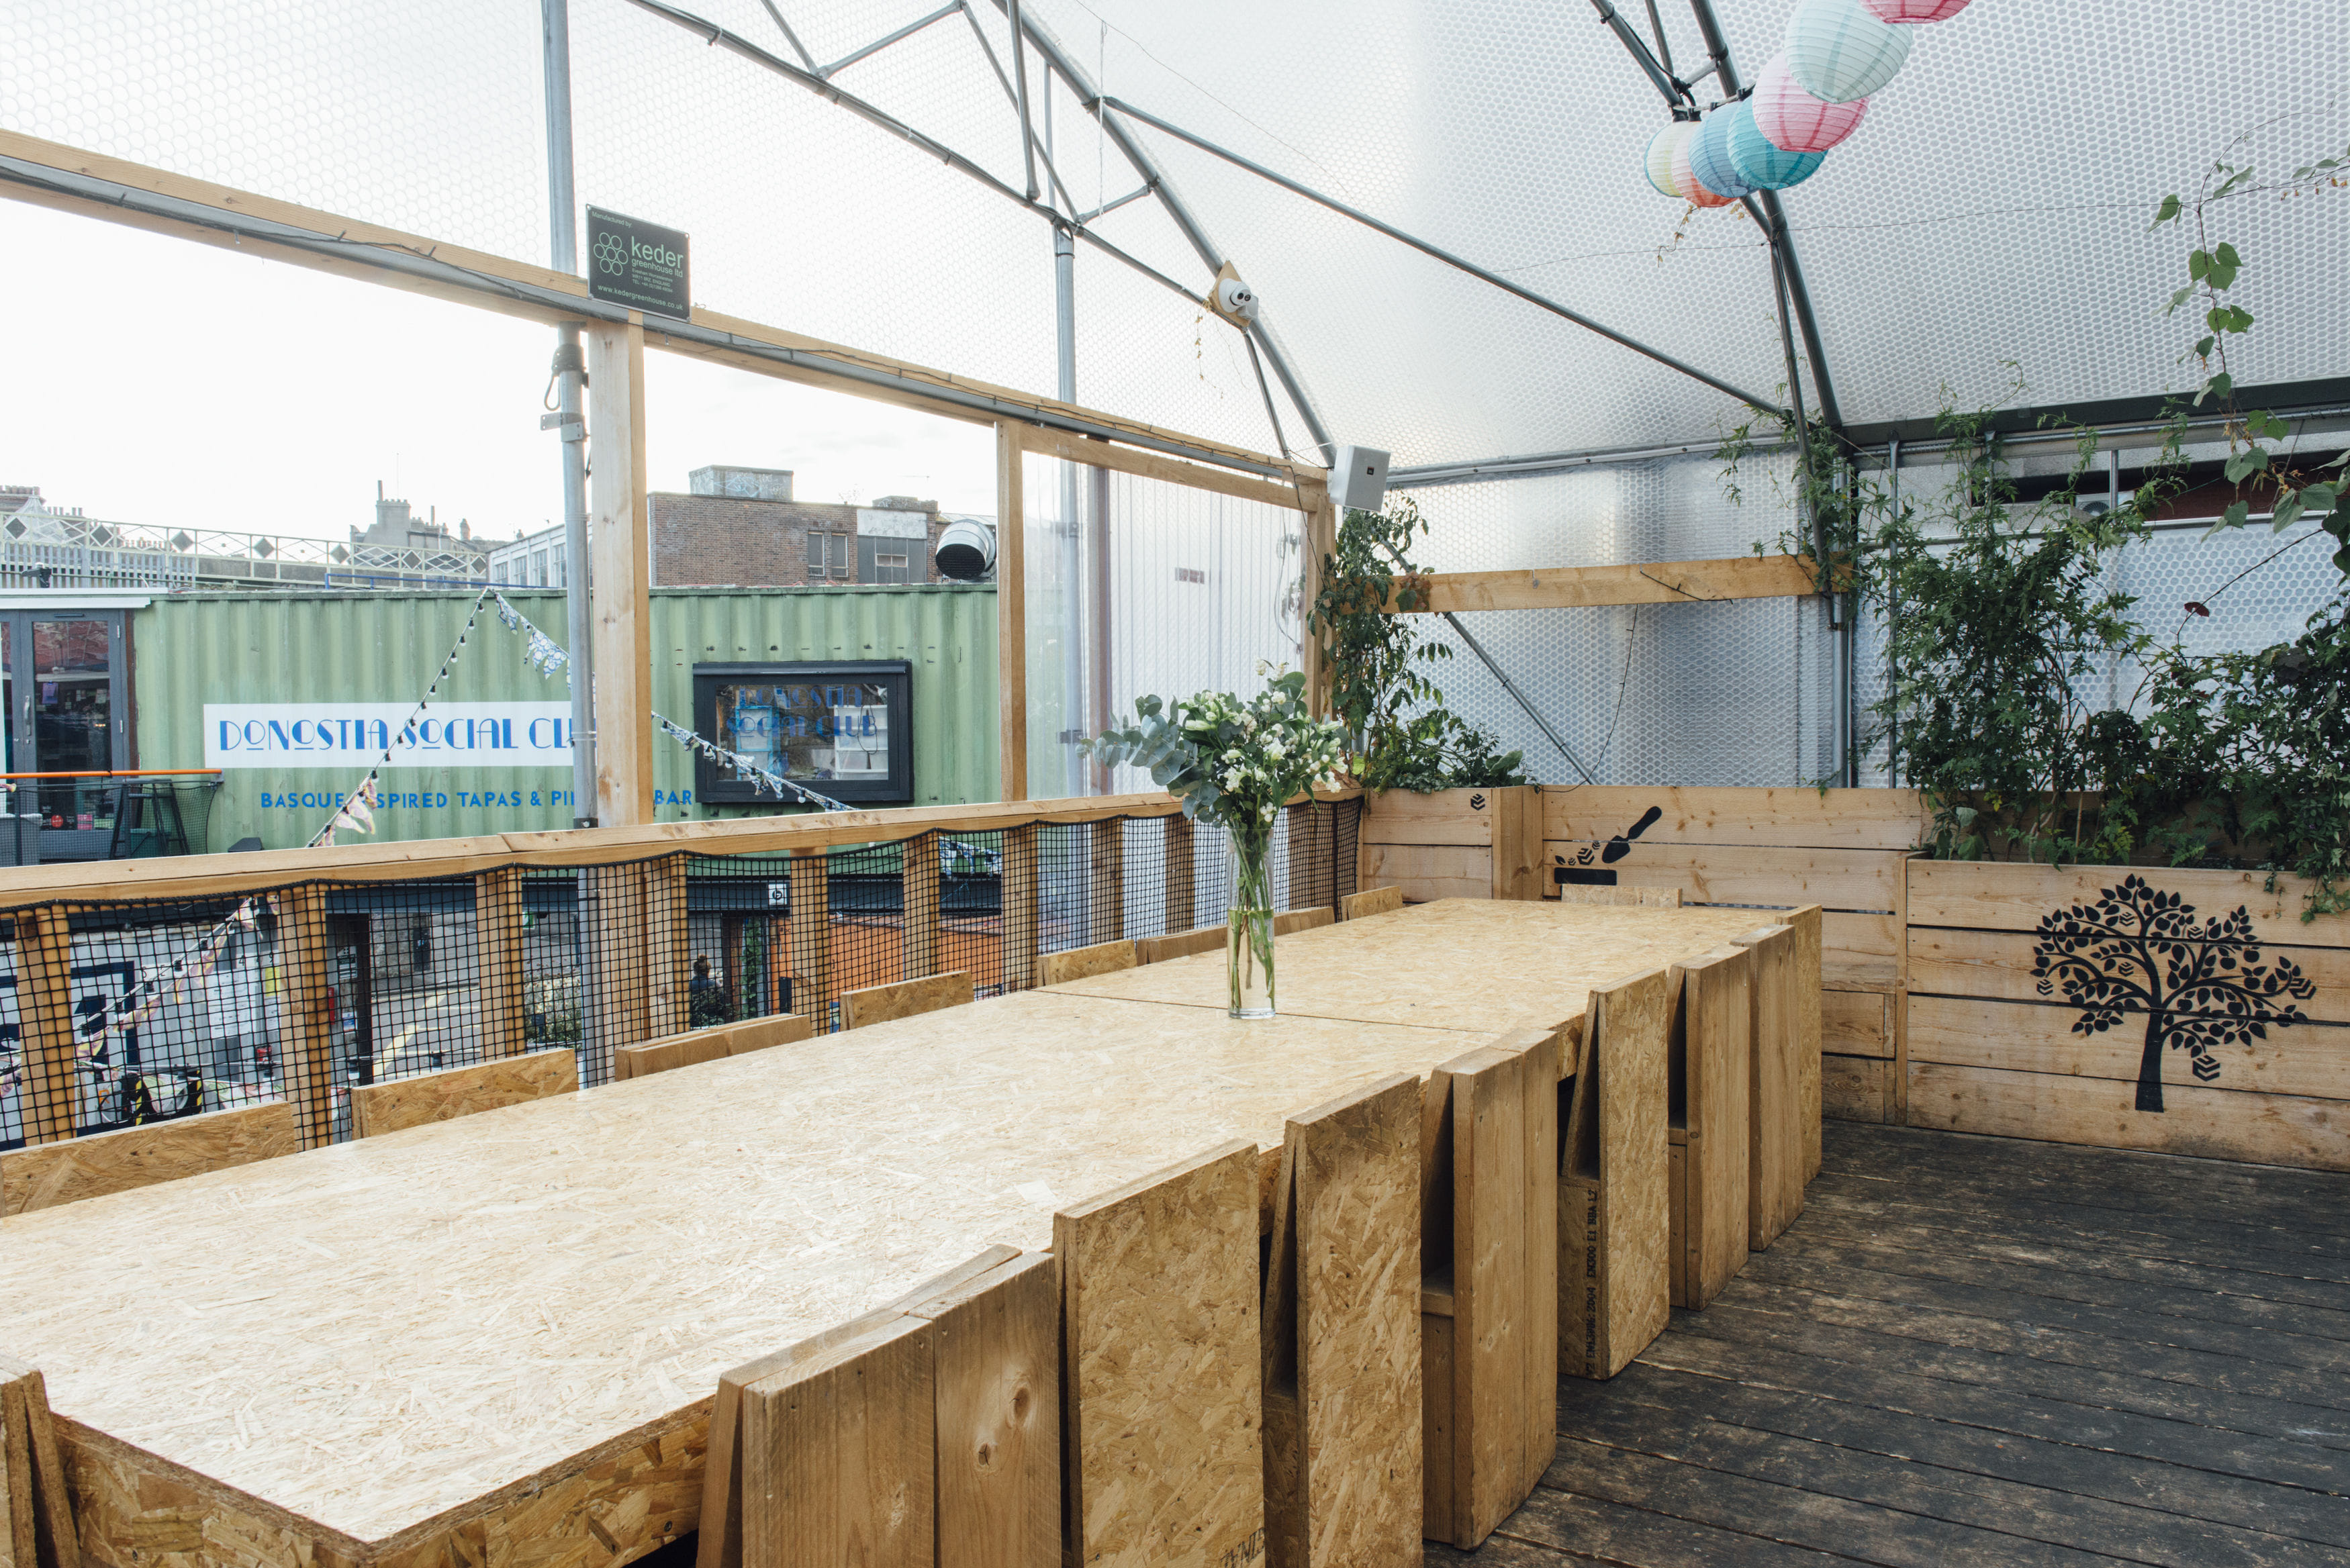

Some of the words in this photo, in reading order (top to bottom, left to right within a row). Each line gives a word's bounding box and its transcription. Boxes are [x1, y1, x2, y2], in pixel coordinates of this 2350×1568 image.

[592, 211, 624, 225] Manufactured
[631, 236, 684, 269] keder
[632, 258, 673, 275] greenhouse
[674, 268, 684, 278] ltd
[597, 284, 684, 311] www.kedergreenhouse.co.uk
[739, 687, 863, 709] DONOSTIA
[220, 719, 388, 750] DONOSTIA
[403, 718, 519, 750] SOCIAL
[726, 716, 810, 737] SOCIAL
[816, 716, 878, 737] CLUB
[261, 792, 344, 808] BASQUE
[363, 792, 448, 808] SPIRED
[457, 791, 522, 807] TAPAS
[530, 791, 542, 806] &
[654, 789, 692, 805] BAR
